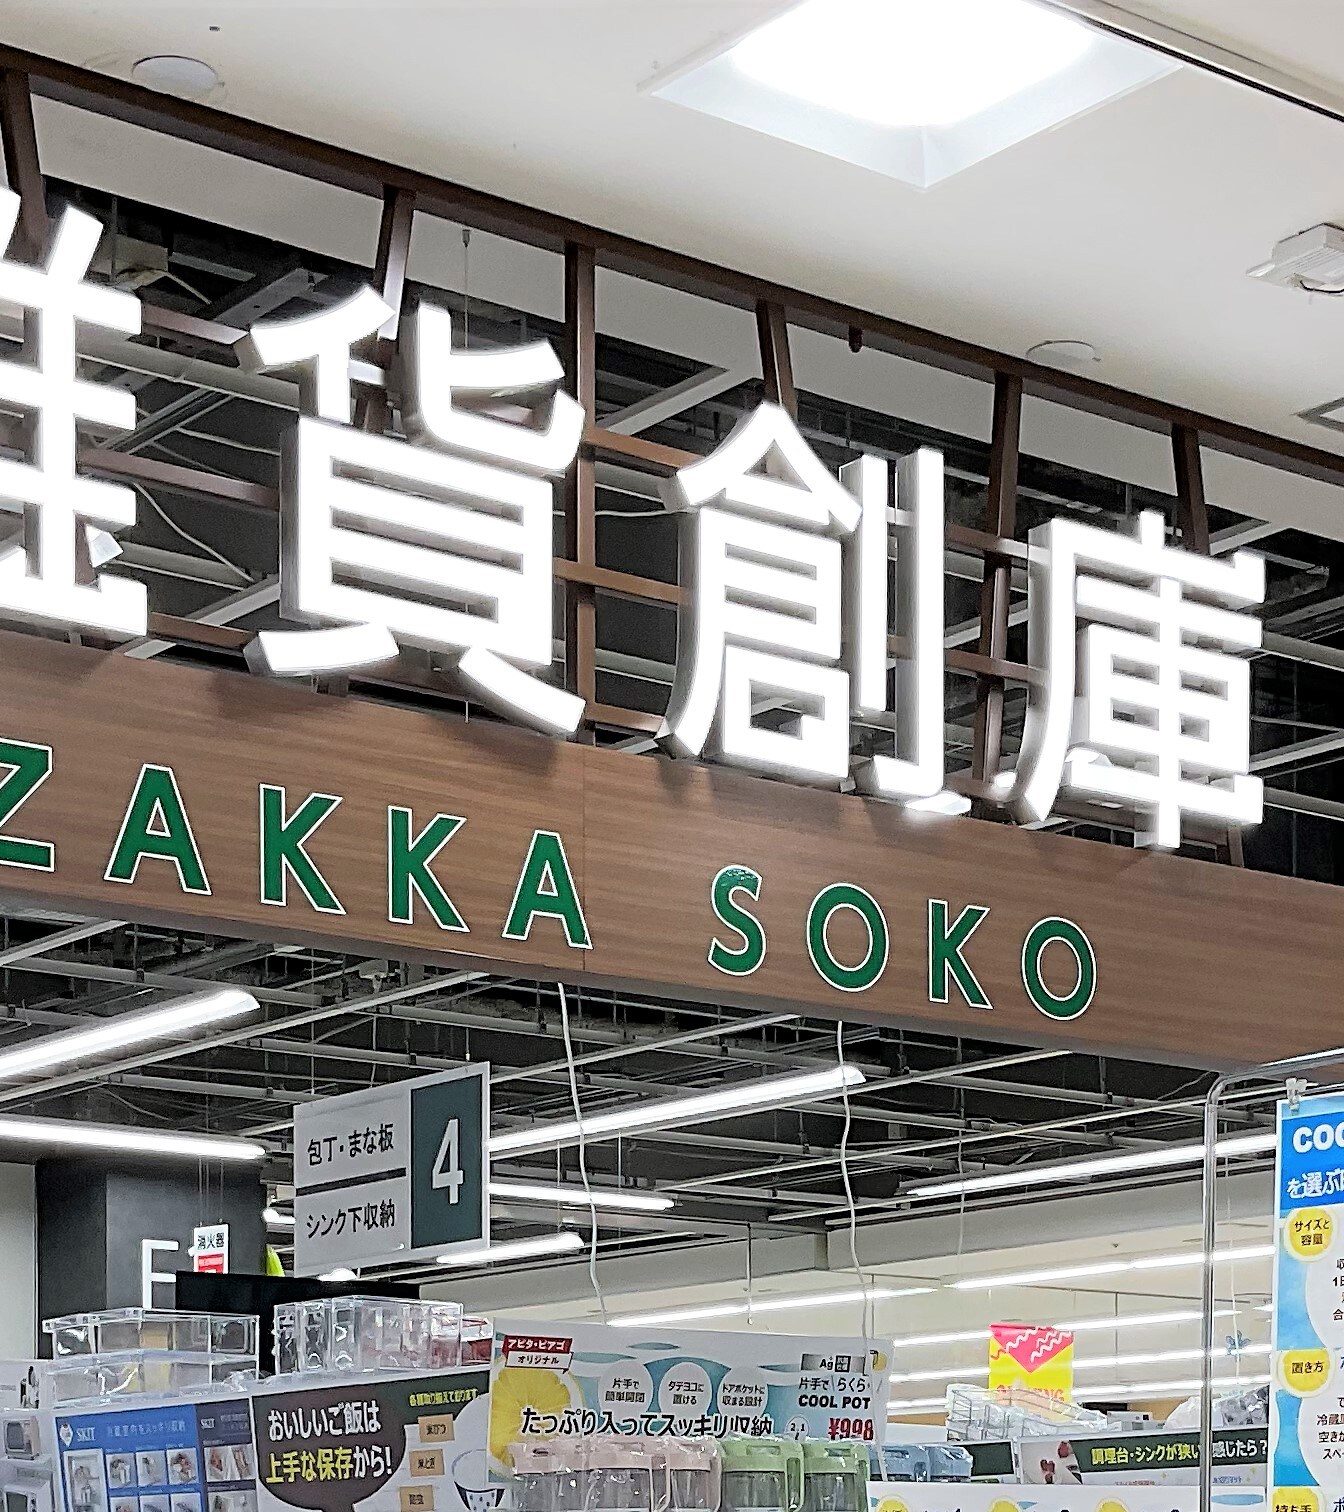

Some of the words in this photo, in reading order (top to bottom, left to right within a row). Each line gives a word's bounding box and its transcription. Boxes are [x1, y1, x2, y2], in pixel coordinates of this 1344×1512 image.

[708, 865, 1098, 1020] SOKO
[307, 1123, 395, 1166] 包丁・まな板
[431, 1119, 464, 1204] 4
[306, 1199, 396, 1237] シンク下収納
[1294, 1218, 1330, 1232] サイズと
[517, 1354, 560, 1365] オリジナル
[267, 1400, 380, 1441] おいしいご飯は
[798, 1394, 837, 1408] COOL
[842, 1397, 870, 1409] POT
[265, 1445, 393, 1483] 上手な保存から!
